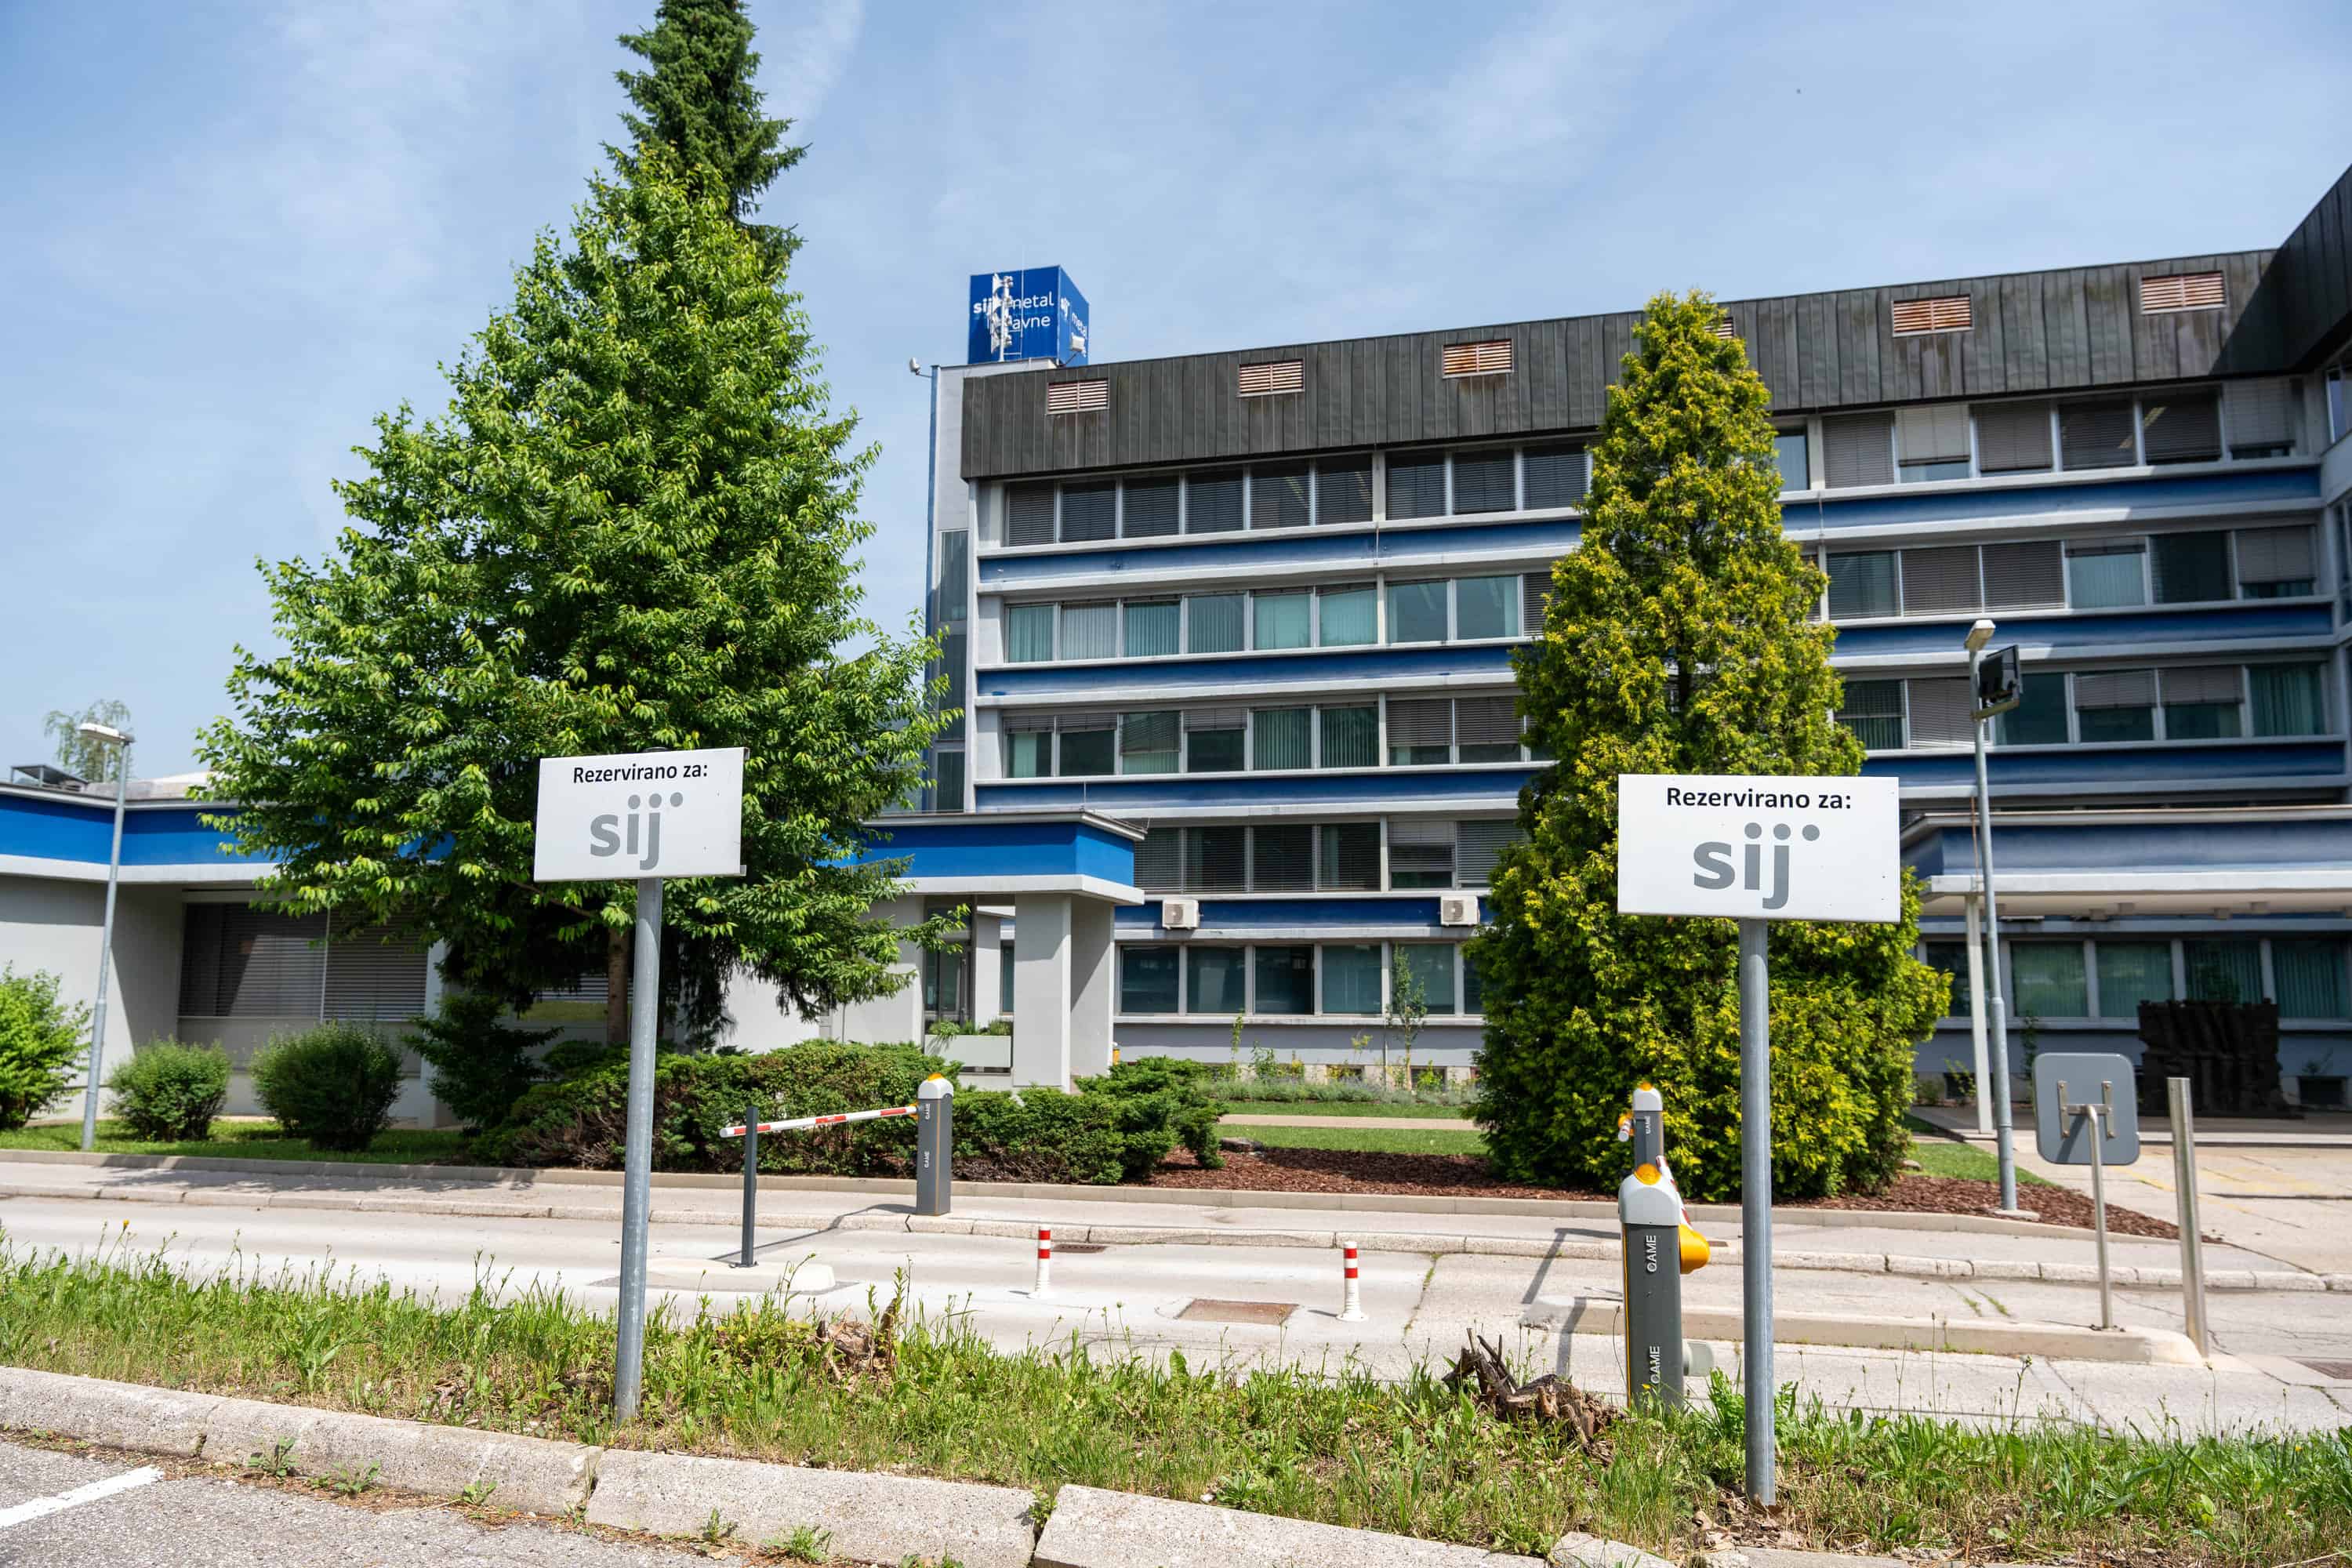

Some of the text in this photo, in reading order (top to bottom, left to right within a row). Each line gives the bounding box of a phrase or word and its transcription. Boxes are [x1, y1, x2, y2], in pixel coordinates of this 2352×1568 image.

[572, 763, 708, 784] Rezervirano za:
[1666, 787, 1852, 810] Rezervirano za:
[590, 793, 662, 871] sij
[1693, 822, 1791, 910] sij
